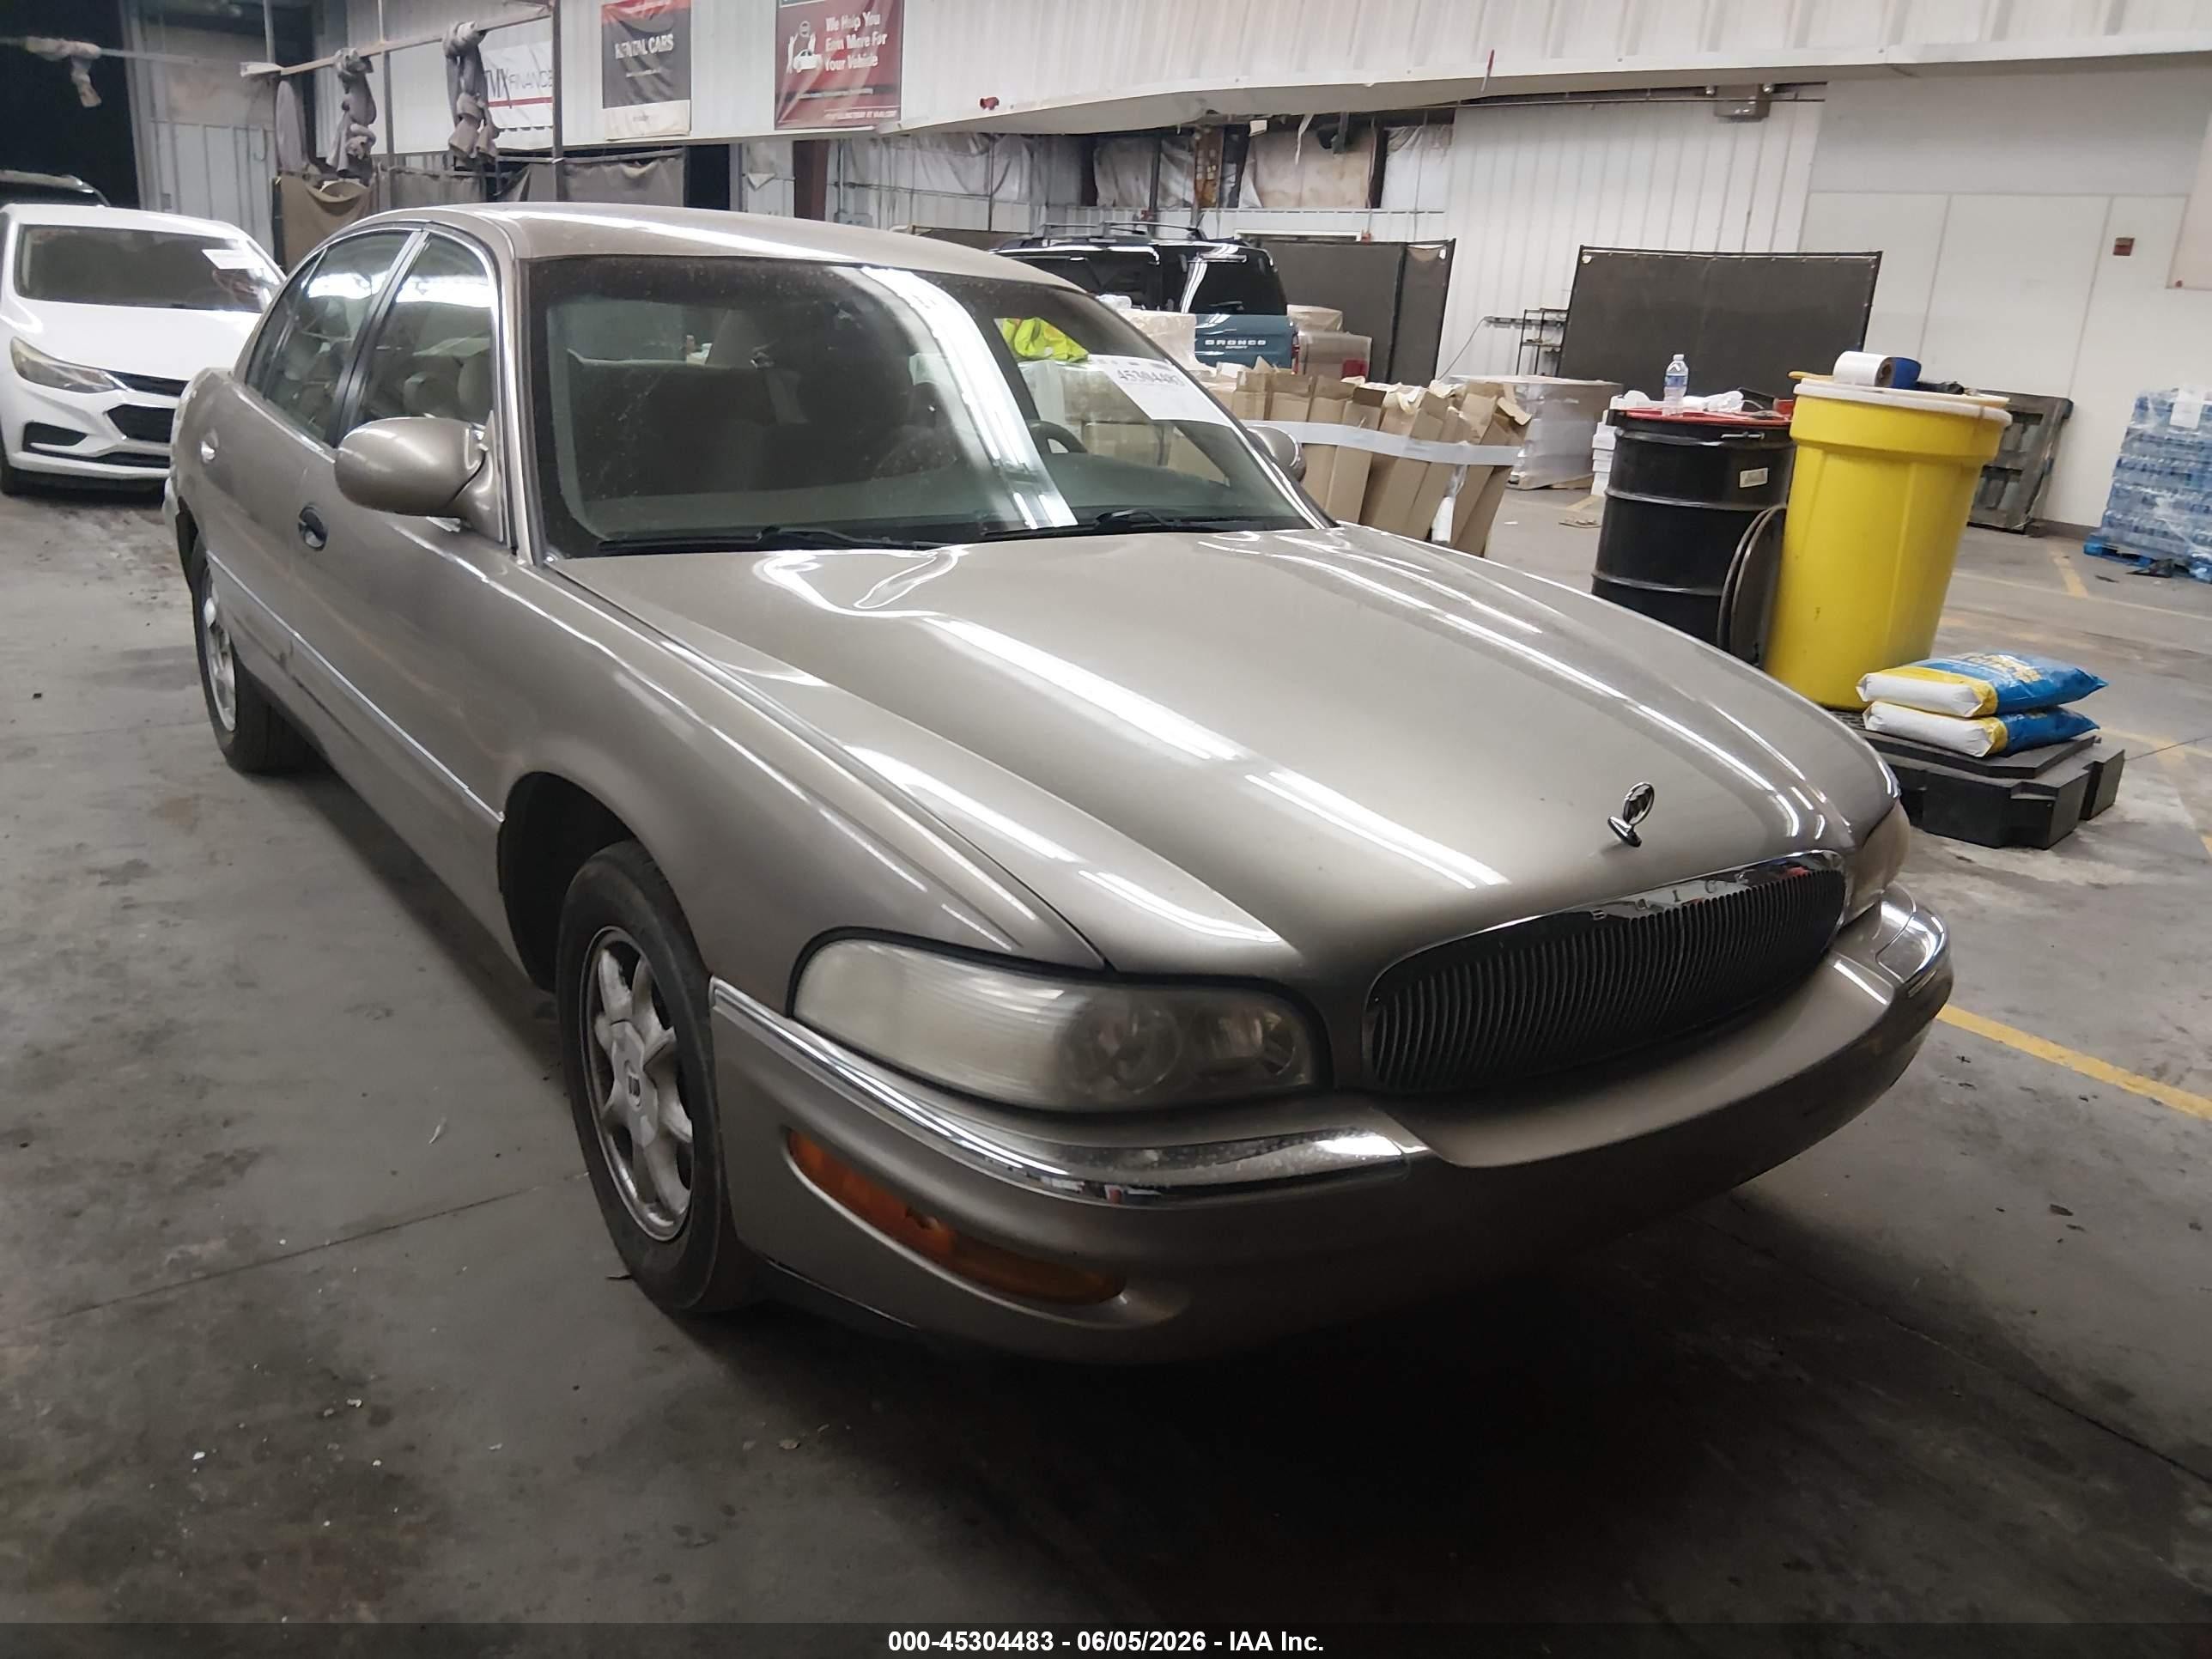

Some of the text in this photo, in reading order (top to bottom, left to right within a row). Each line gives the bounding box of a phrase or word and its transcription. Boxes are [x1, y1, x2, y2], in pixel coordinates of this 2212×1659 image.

[825, 16, 840, 32] We
[862, 11, 881, 27] You
[648, 33, 674, 53] CARS
[846, 33, 871, 49] More
[872, 31, 888, 46] For
[824, 57, 846, 71] Your
